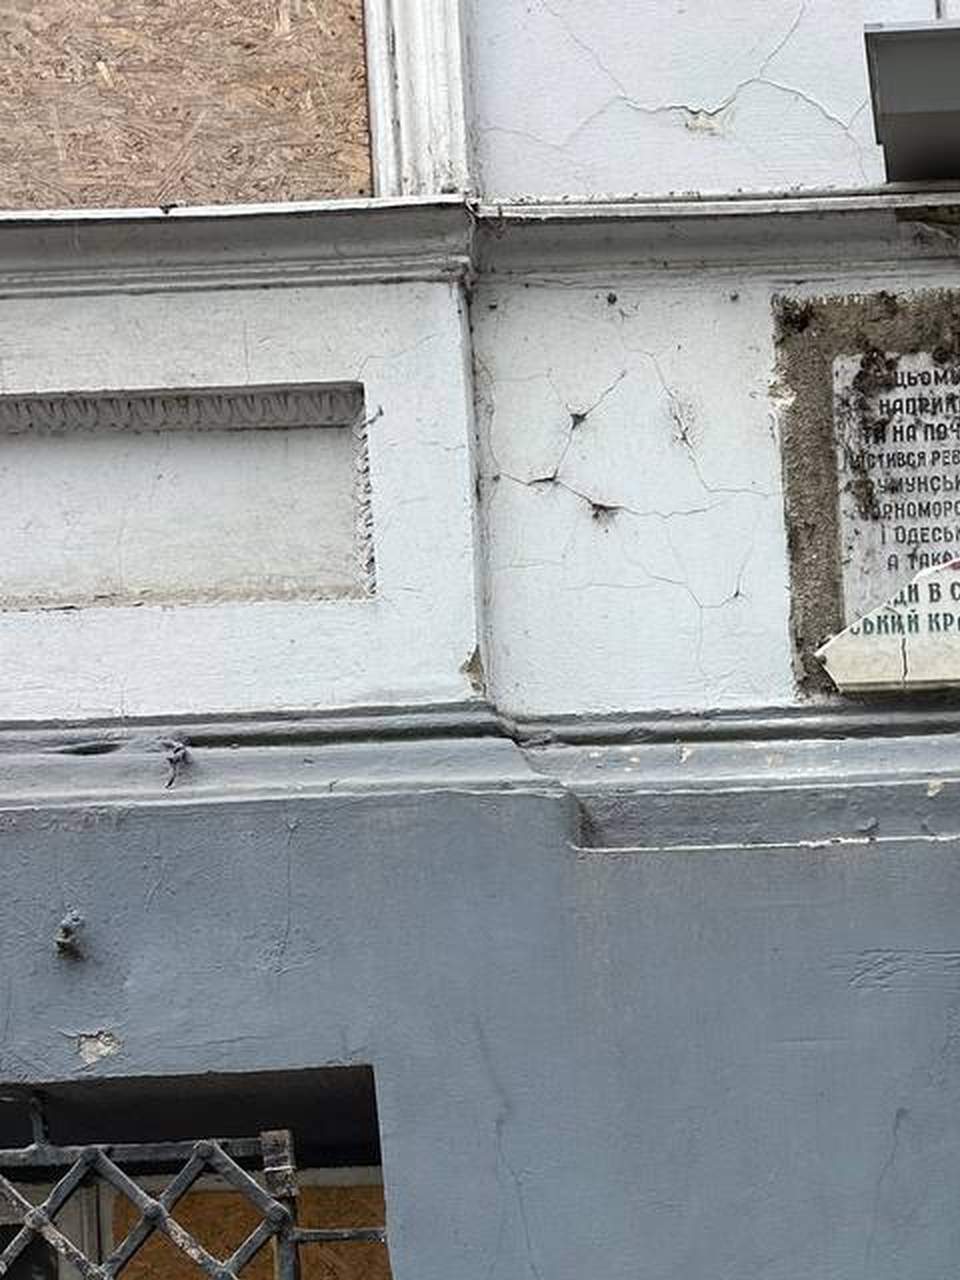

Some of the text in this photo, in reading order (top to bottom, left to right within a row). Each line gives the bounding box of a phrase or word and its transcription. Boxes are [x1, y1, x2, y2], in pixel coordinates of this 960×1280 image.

[892, 424, 917, 442] НА
[887, 554, 899, 571] А
[929, 582, 942, 603] В
